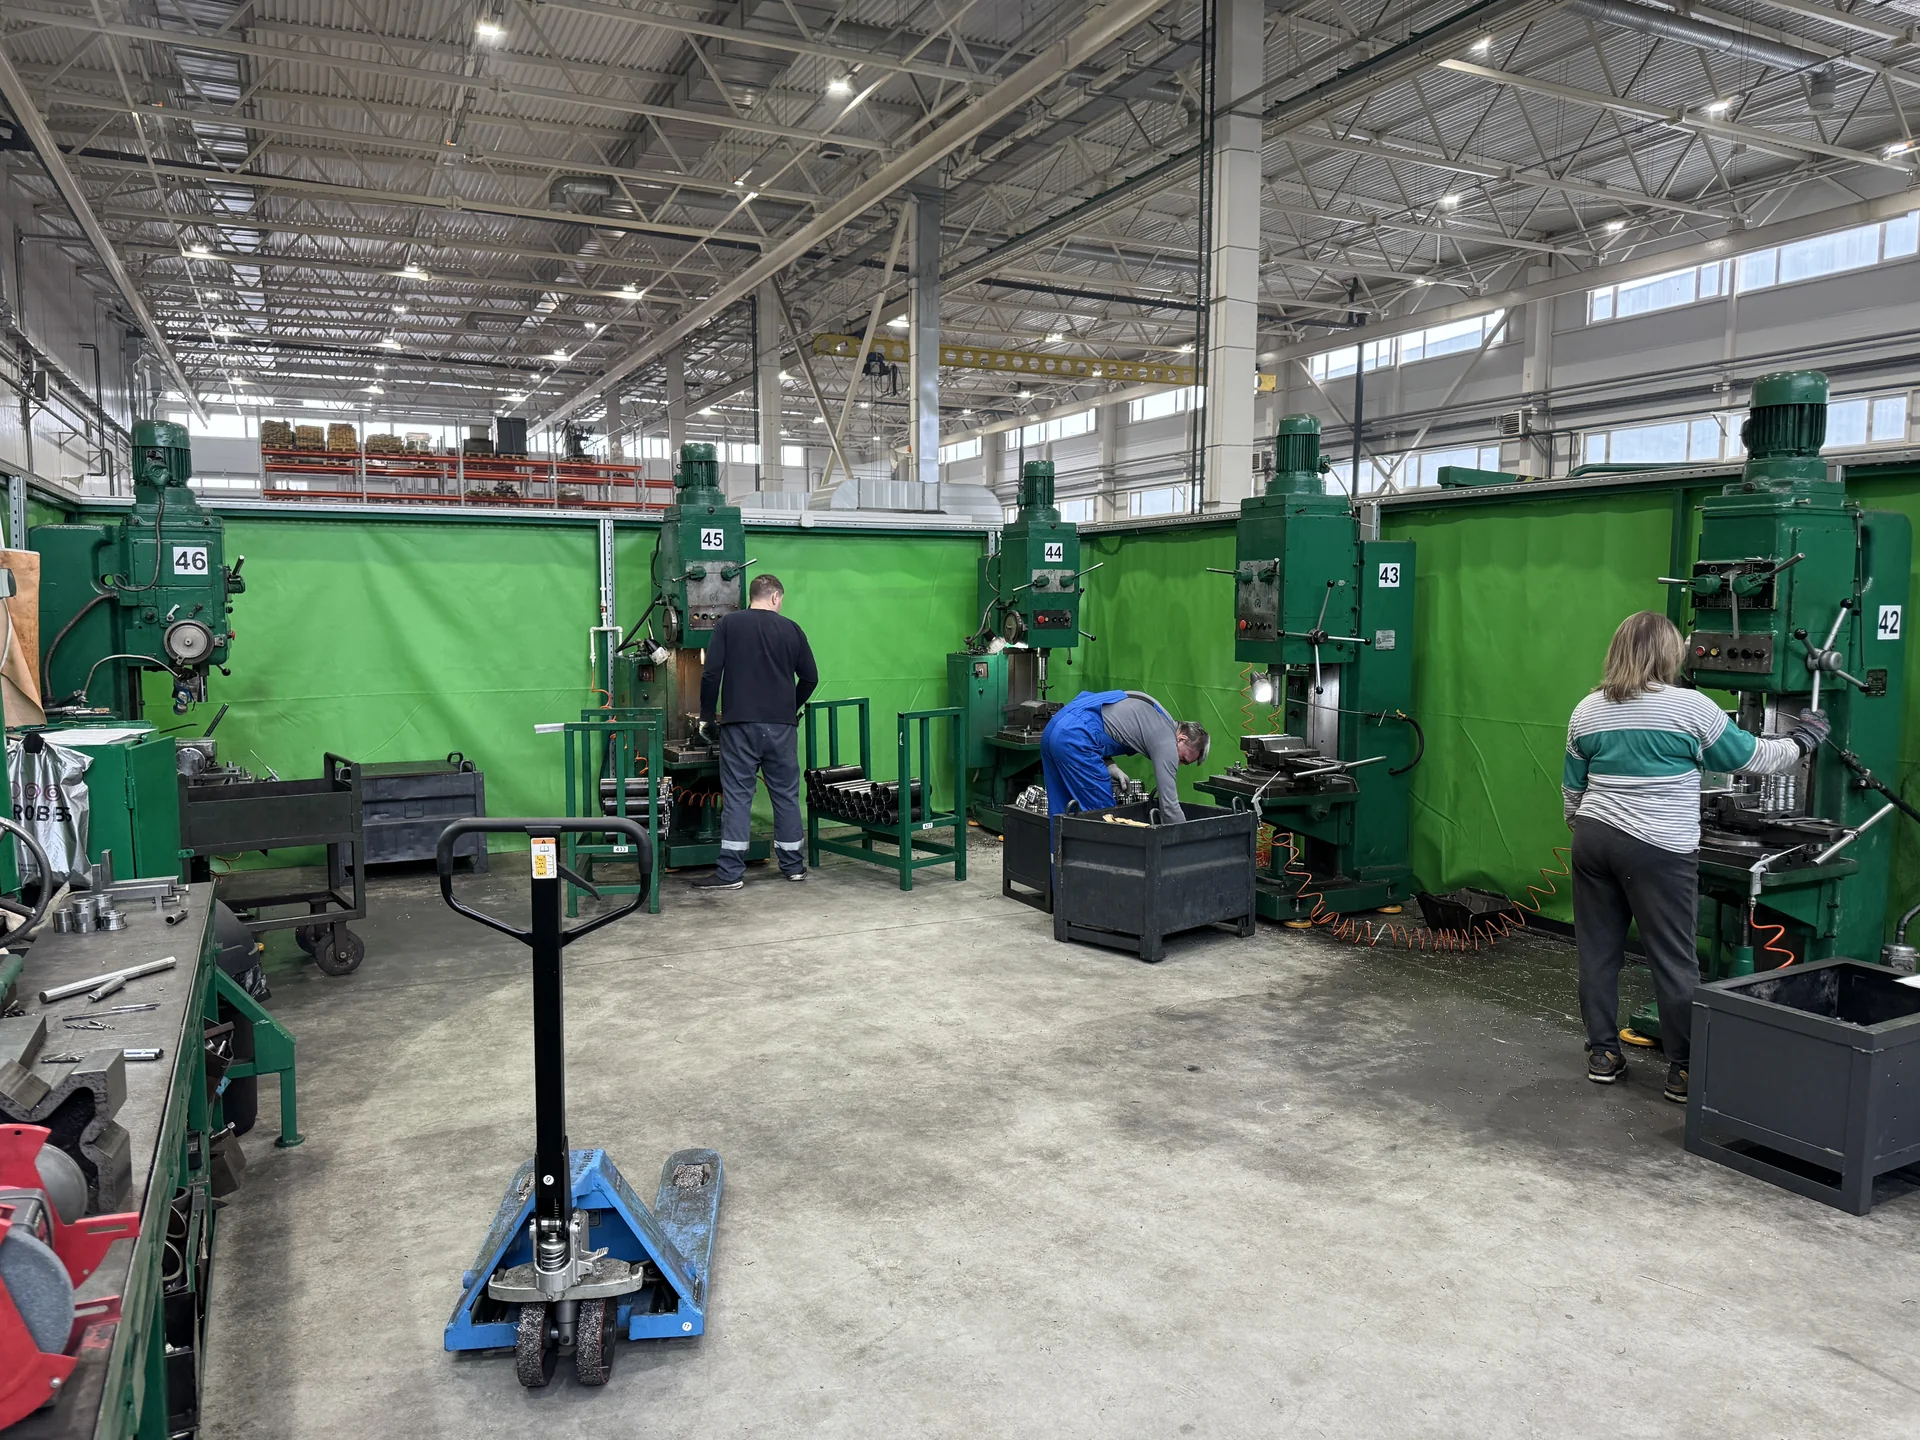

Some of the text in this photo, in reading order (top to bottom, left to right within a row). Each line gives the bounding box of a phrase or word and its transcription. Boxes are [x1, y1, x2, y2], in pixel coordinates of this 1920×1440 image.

[702, 532, 723, 546] 45
[175, 551, 206, 571] 46
[1045, 545, 1062, 559] 44
[1379, 566, 1399, 584] 43
[1878, 610, 1899, 634] 42
